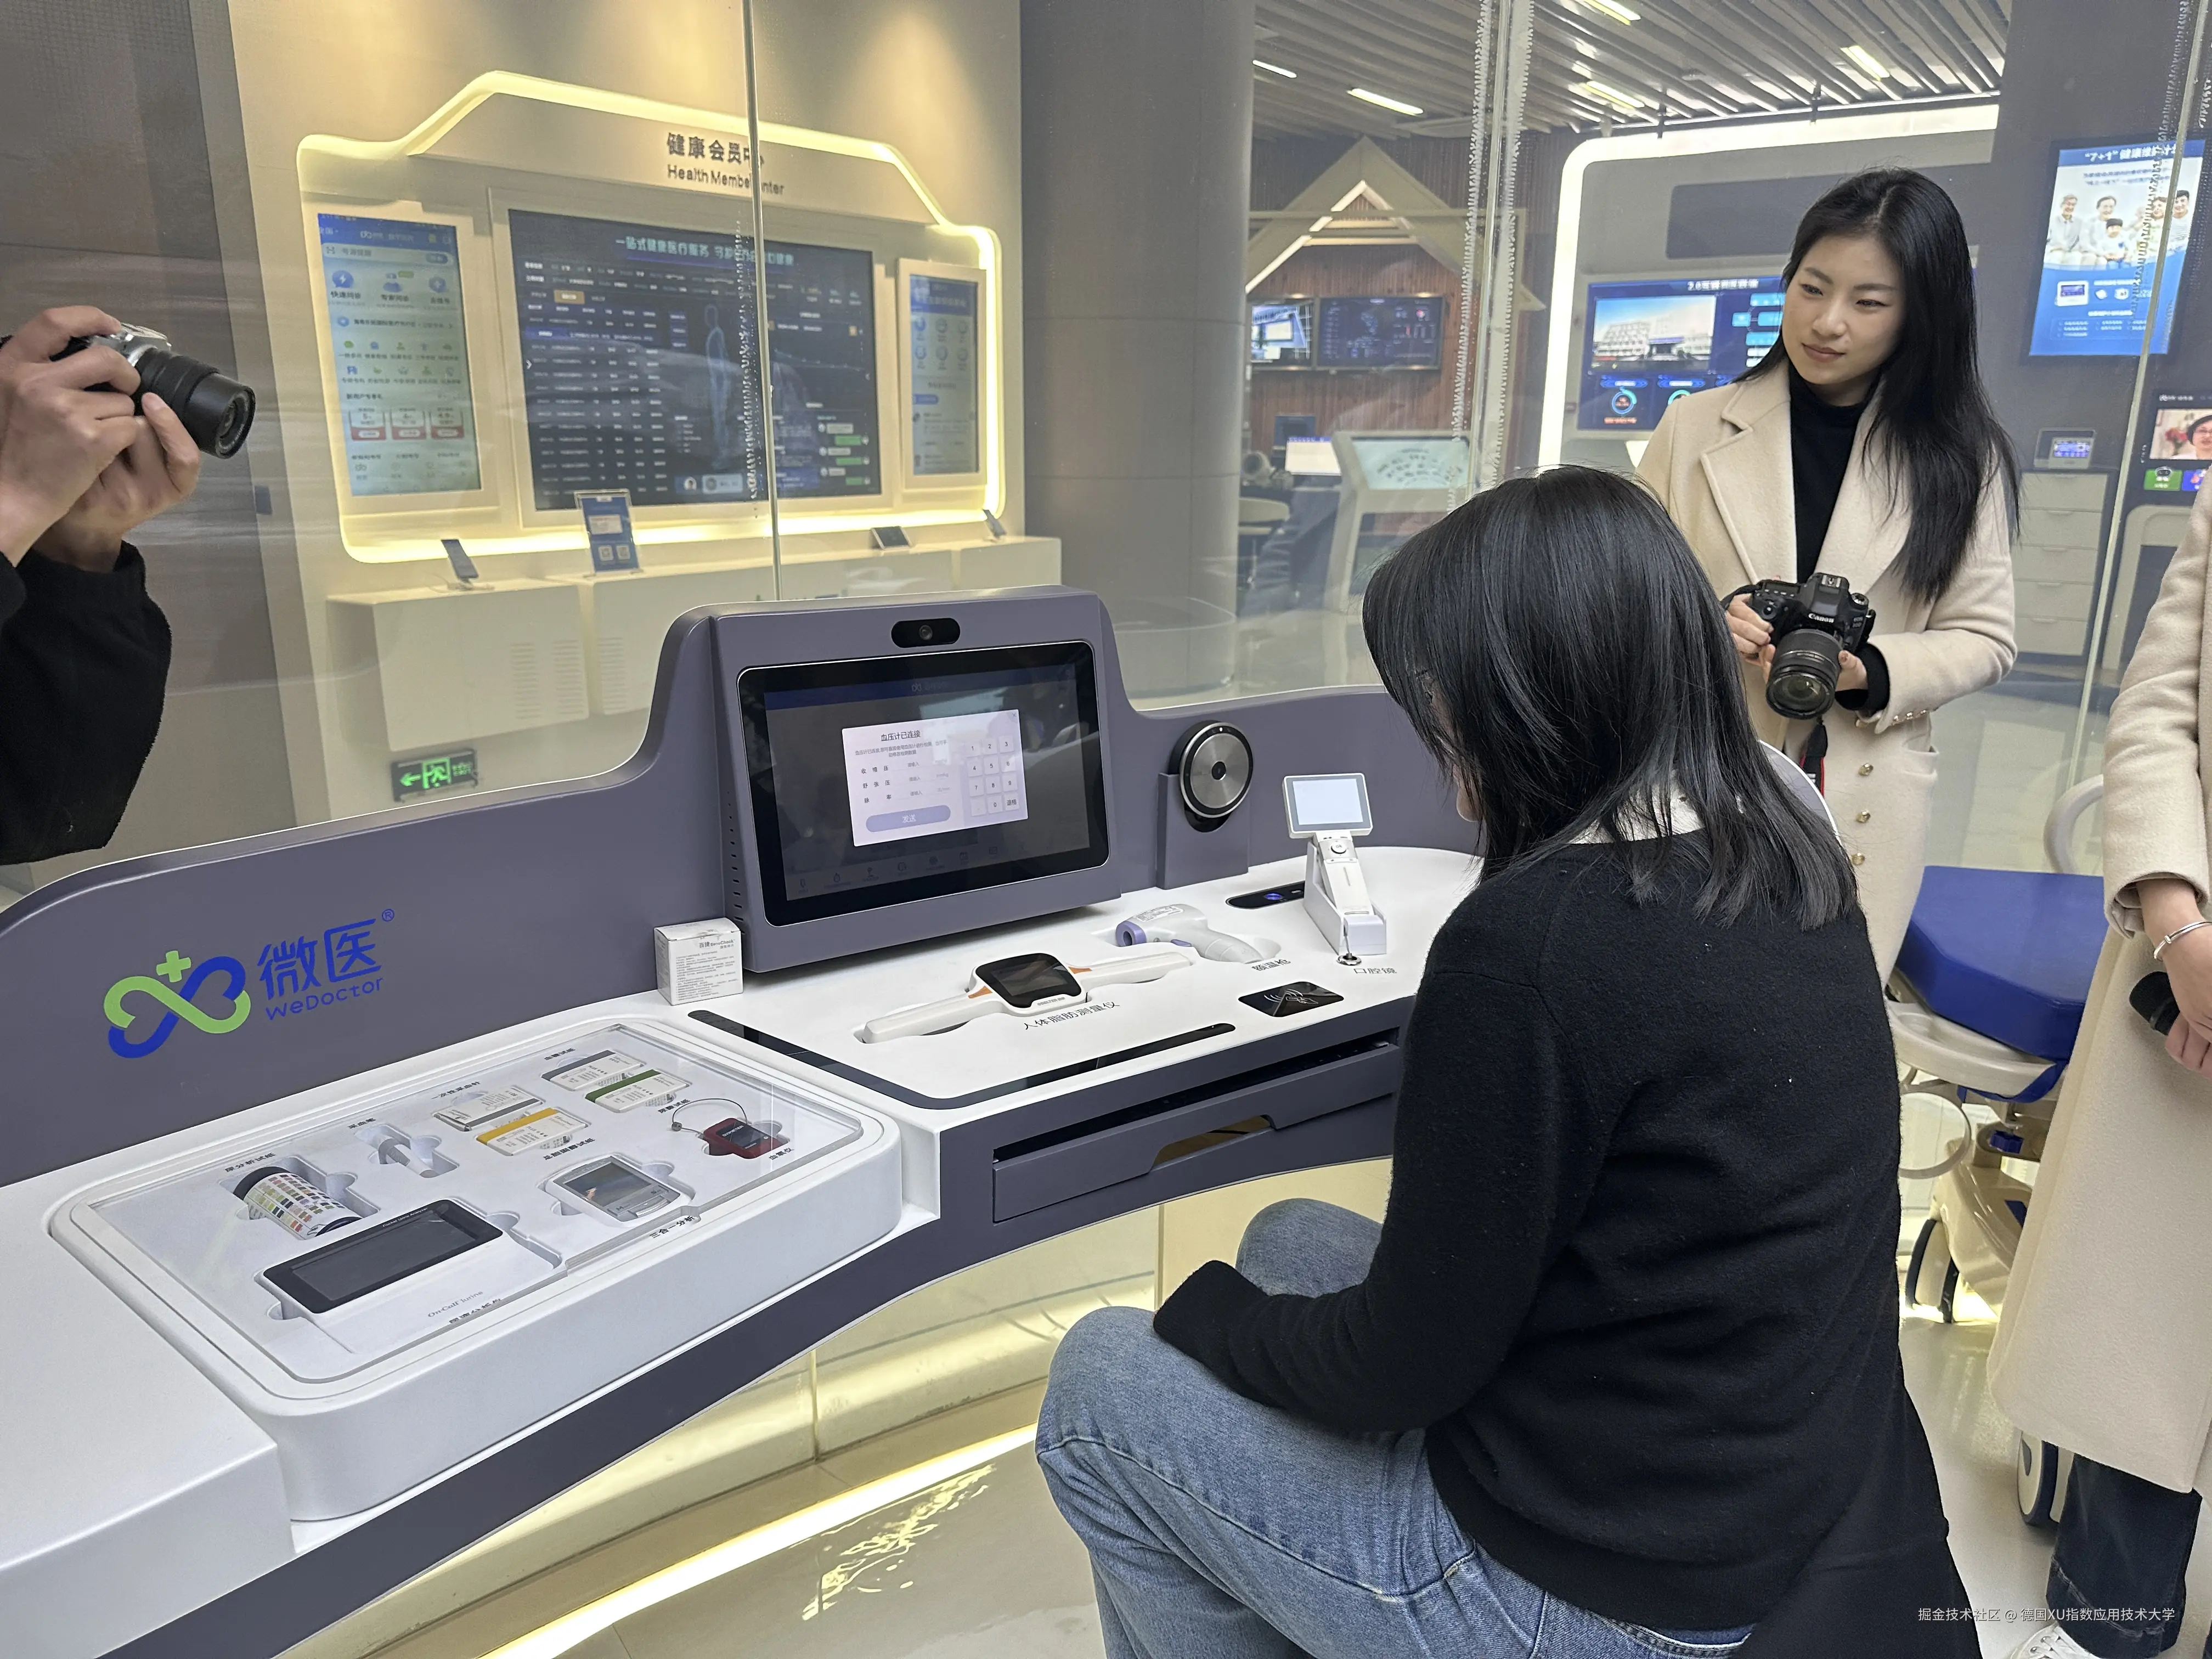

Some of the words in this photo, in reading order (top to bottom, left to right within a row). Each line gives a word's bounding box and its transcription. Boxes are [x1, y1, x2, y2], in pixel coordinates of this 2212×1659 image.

[667, 132, 765, 167] 健康会员中
[667, 164, 709, 183] Health
[711, 171, 752, 189] Membe
[1808, 613, 1835, 623] Canon
[881, 730, 921, 741] 血压计已连接
[902, 814, 916, 823] 发送
[257, 918, 382, 1001] 微医
[1251, 959, 1291, 971] 额温枪
[1024, 1001, 1120, 1030] 人体脂肪测量仪
